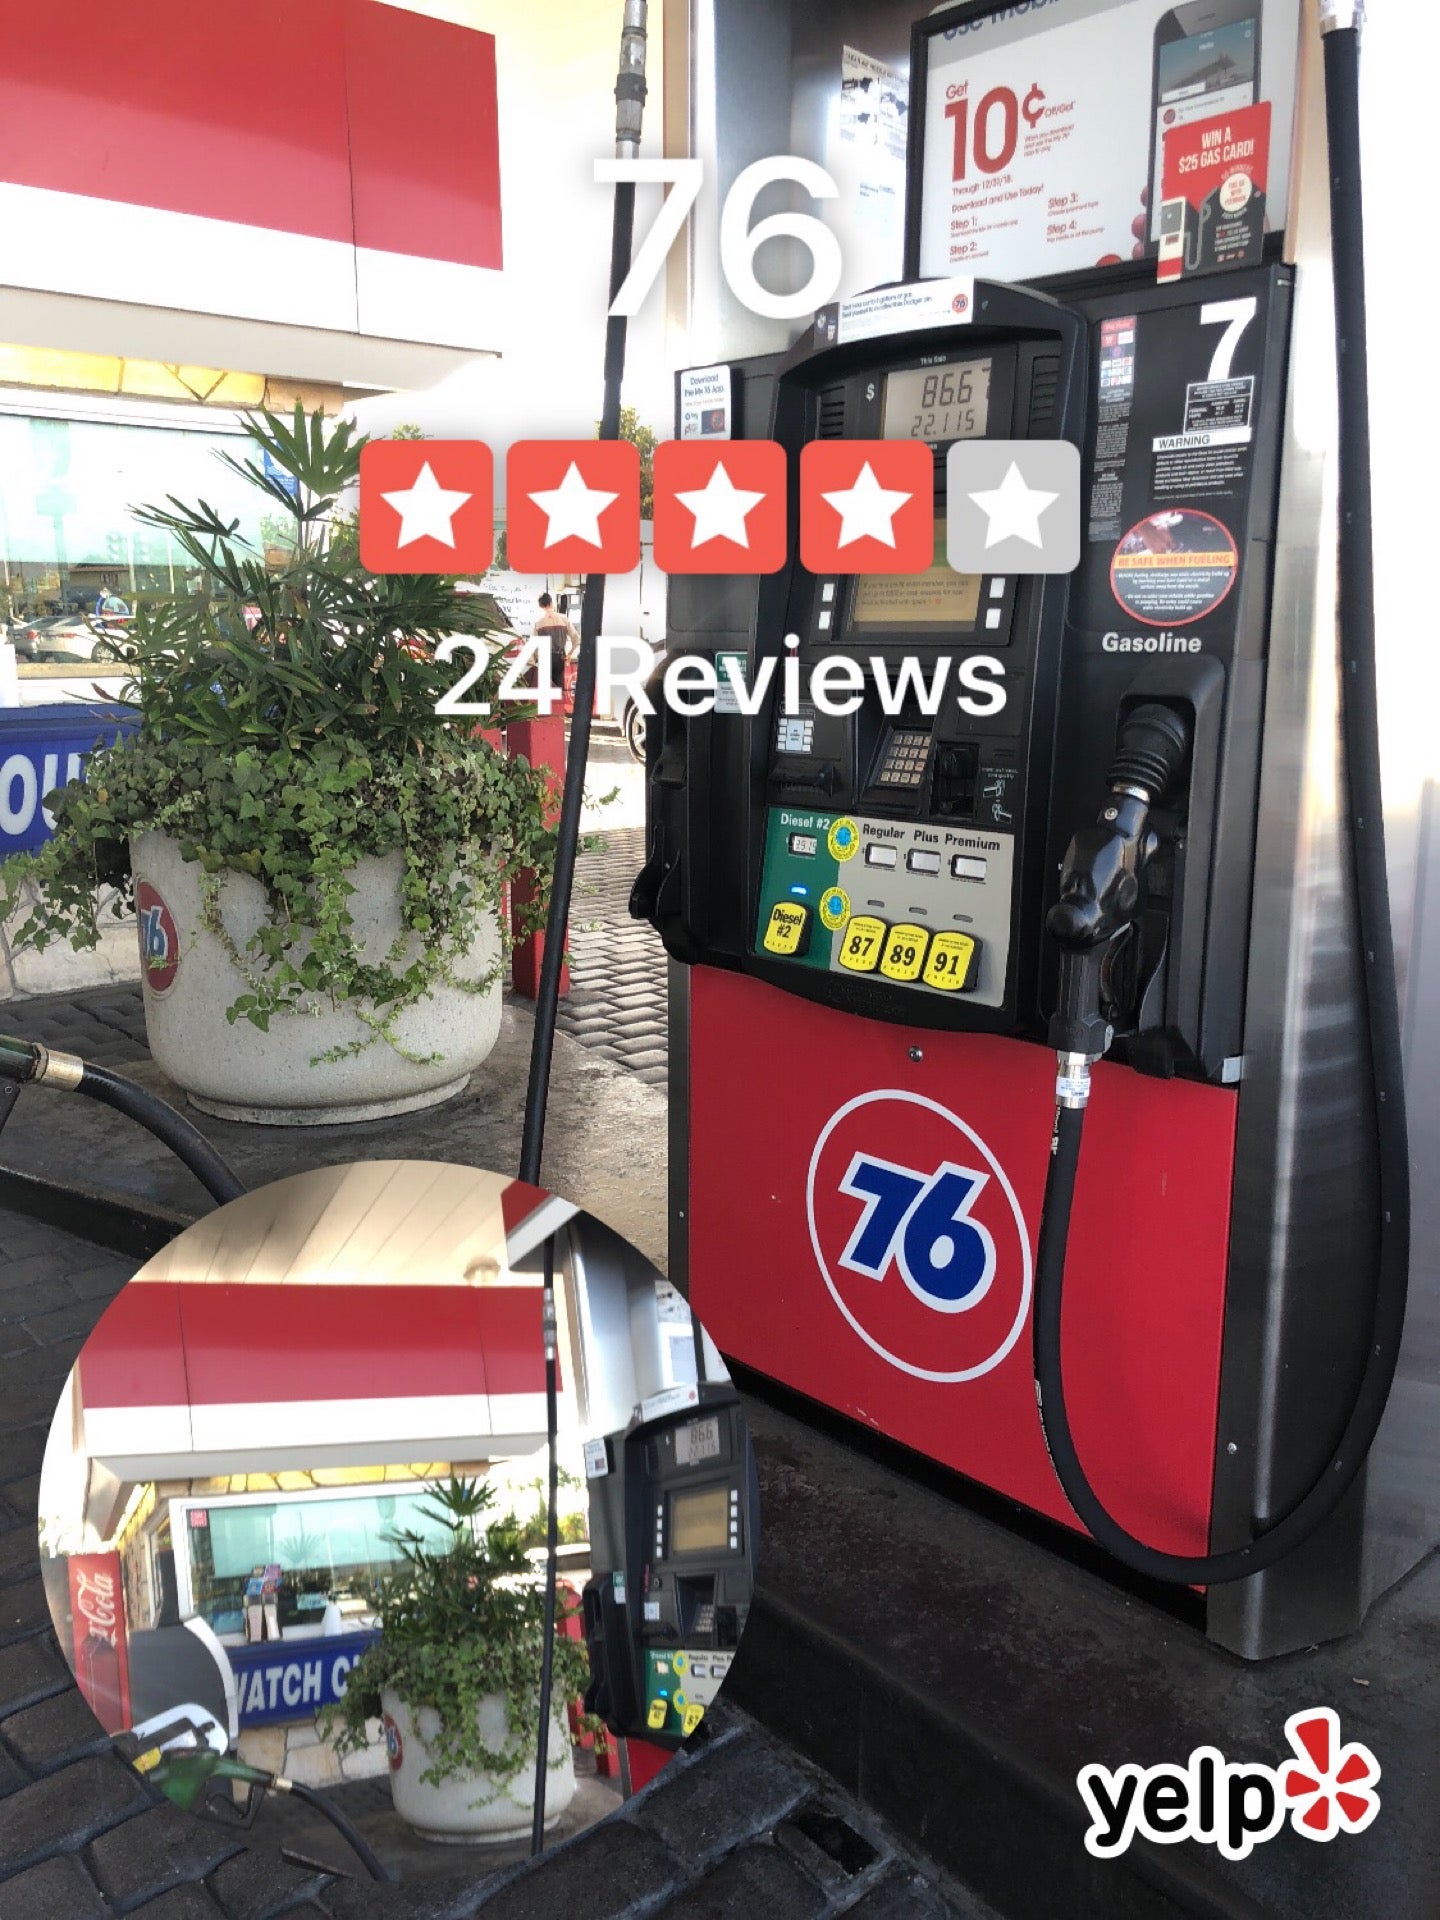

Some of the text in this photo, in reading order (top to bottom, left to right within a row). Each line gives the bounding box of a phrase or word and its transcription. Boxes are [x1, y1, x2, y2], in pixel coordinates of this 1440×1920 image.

[945, 79, 969, 100] Get
[1201, 126, 1232, 149] WIN A
[1178, 155, 1199, 174] $25
[1200, 148, 1221, 168] GAS
[1223, 139, 1254, 162] CARD!
[952, 182, 980, 197] Through
[951, 195, 988, 215] Download
[989, 191, 1003, 205] and
[1004, 189, 1018, 202] Use
[1048, 192, 1079, 211] Step 3:
[950, 217, 970, 231] Step
[1046, 219, 1078, 237] Step 4:
[949, 243, 969, 257] Step
[969, 241, 978, 252] 2:
[956, 300, 966, 309] 76
[1200, 296, 1257, 383] 7
[920, 355, 947, 366] This Sale
[690, 373, 719, 386] Download
[866, 383, 875, 402] $
[1158, 435, 1211, 449] WARNING
[1118, 554, 1230, 567] BE SAFE WHEN FUELING
[1101, 632, 1202, 653] Gasoline
[780, 812, 831, 831] Diesel #2
[862, 823, 906, 840] Regular
[913, 830, 939, 843] Plus
[945, 833, 1001, 851] Premium
[772, 908, 804, 927] Diesel
[776, 924, 792, 939] #2
[848, 935, 875, 957] 87
[889, 944, 916, 967] 89
[933, 951, 960, 976] 91
[837, 1151, 997, 1314] 76
